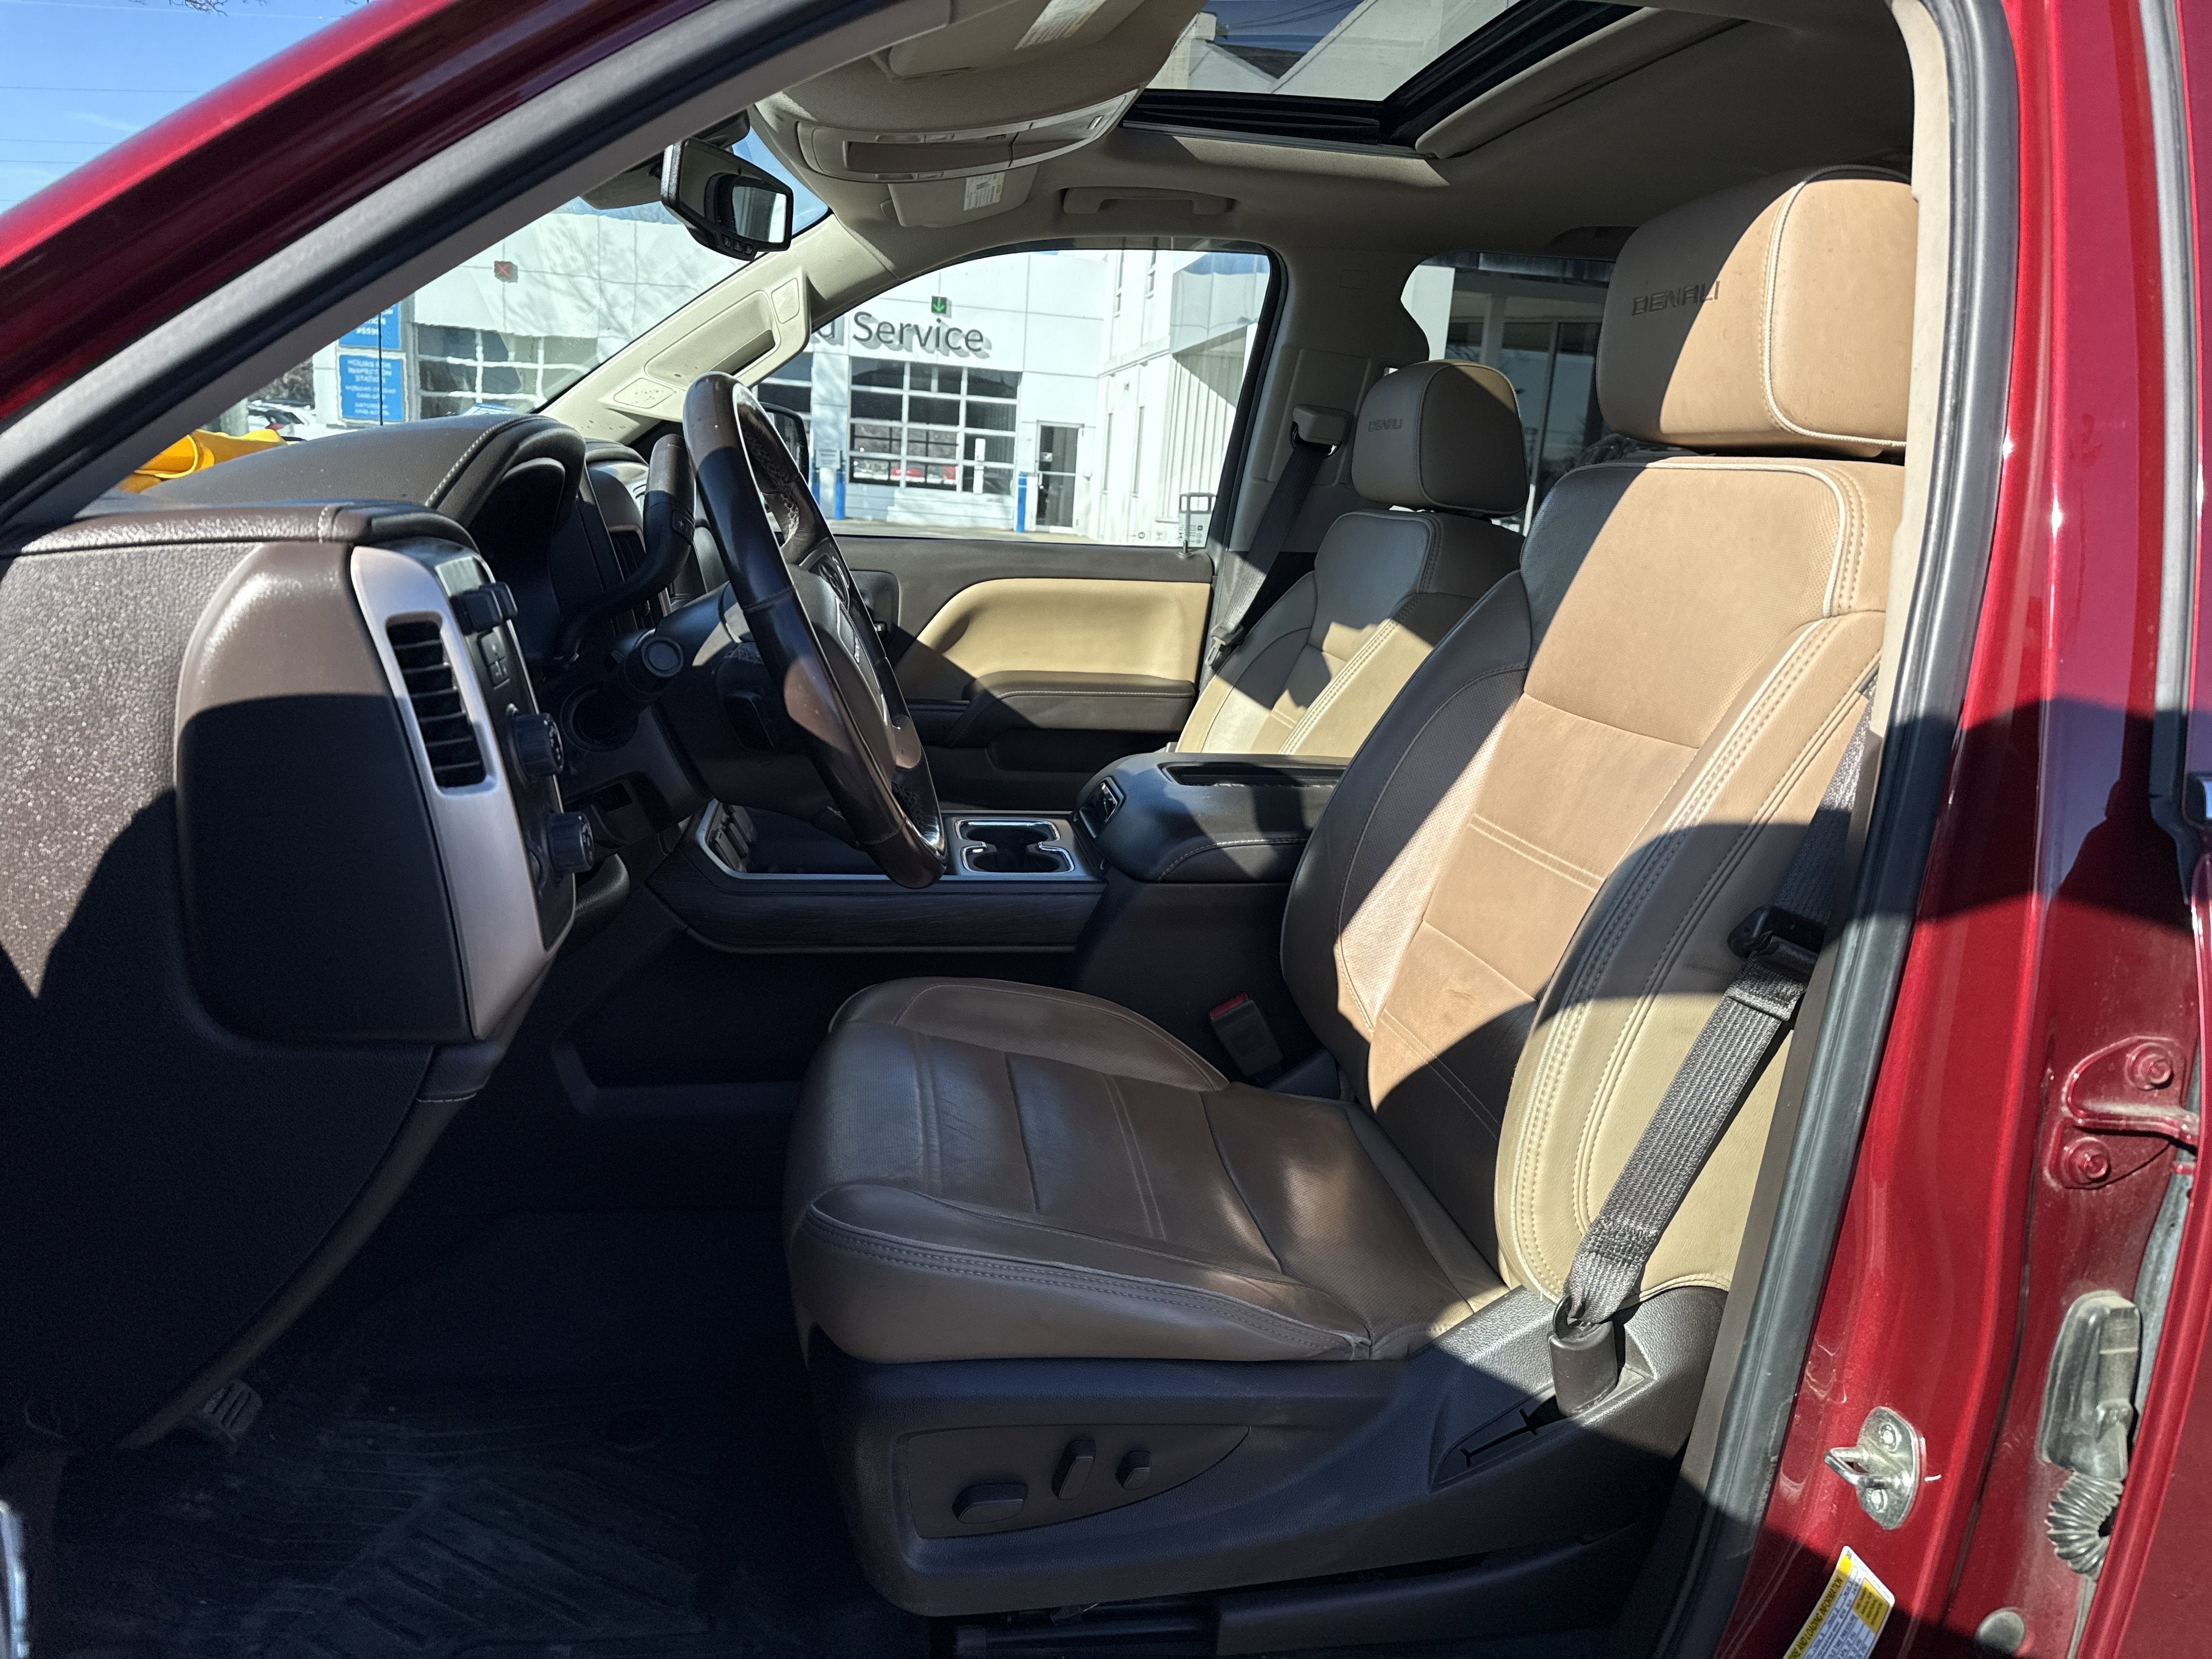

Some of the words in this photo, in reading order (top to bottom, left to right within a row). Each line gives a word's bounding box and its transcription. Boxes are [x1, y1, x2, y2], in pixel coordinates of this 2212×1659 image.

[1632, 280, 1720, 315] DENALI
[852, 311, 984, 353] Service
[347, 367, 392, 377] INSPECTON
